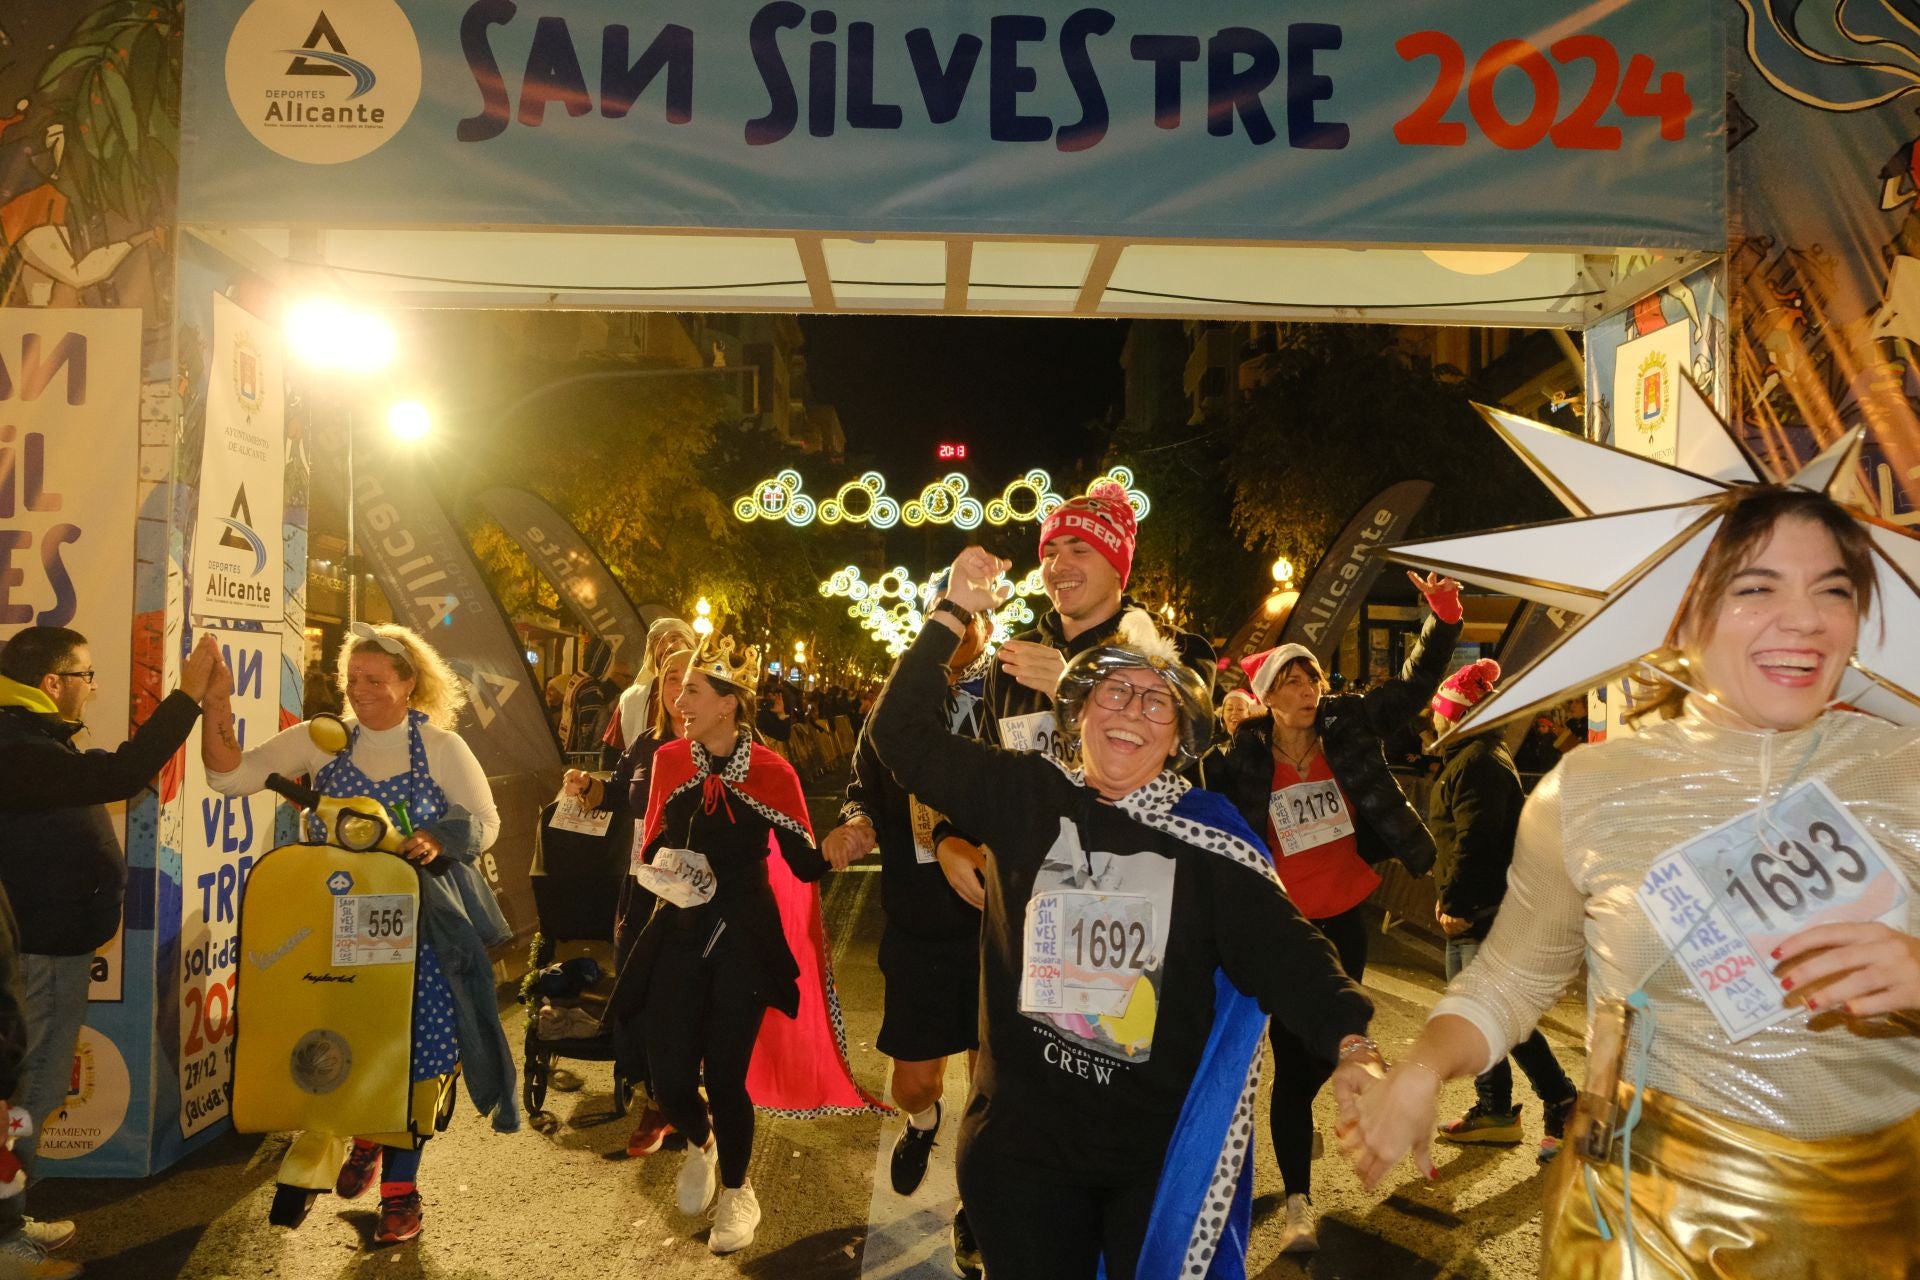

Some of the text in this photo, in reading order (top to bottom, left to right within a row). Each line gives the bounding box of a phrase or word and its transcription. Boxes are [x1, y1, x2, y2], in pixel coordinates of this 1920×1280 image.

[457, 0, 694, 142] SAN
[1393, 30, 1693, 151] 2024
[265, 89, 326, 99] DEPORTES
[265, 101, 385, 123] Alicante
[0, 332, 87, 405] N
[1065, 515, 1122, 553] DEER!
[208, 560, 240, 574] DEPORTES
[1303, 509, 1392, 643] Alicante
[207, 573, 270, 602] Alicante
[1293, 791, 1340, 824] 2178
[1725, 821, 1868, 931] 1693
[368, 909, 403, 937] 556
[1035, 925, 1057, 940] VES
[1034, 941, 1057, 956] TRE
[1071, 918, 1146, 969] 1692
[1029, 964, 1061, 979] 2024
[1700, 955, 1756, 991] 2024
[185, 1051, 217, 1091] 27/12
[1044, 1042, 1114, 1085] CREW
[187, 1087, 224, 1127] Salida:
[43, 1140, 94, 1149] ALICANTE
